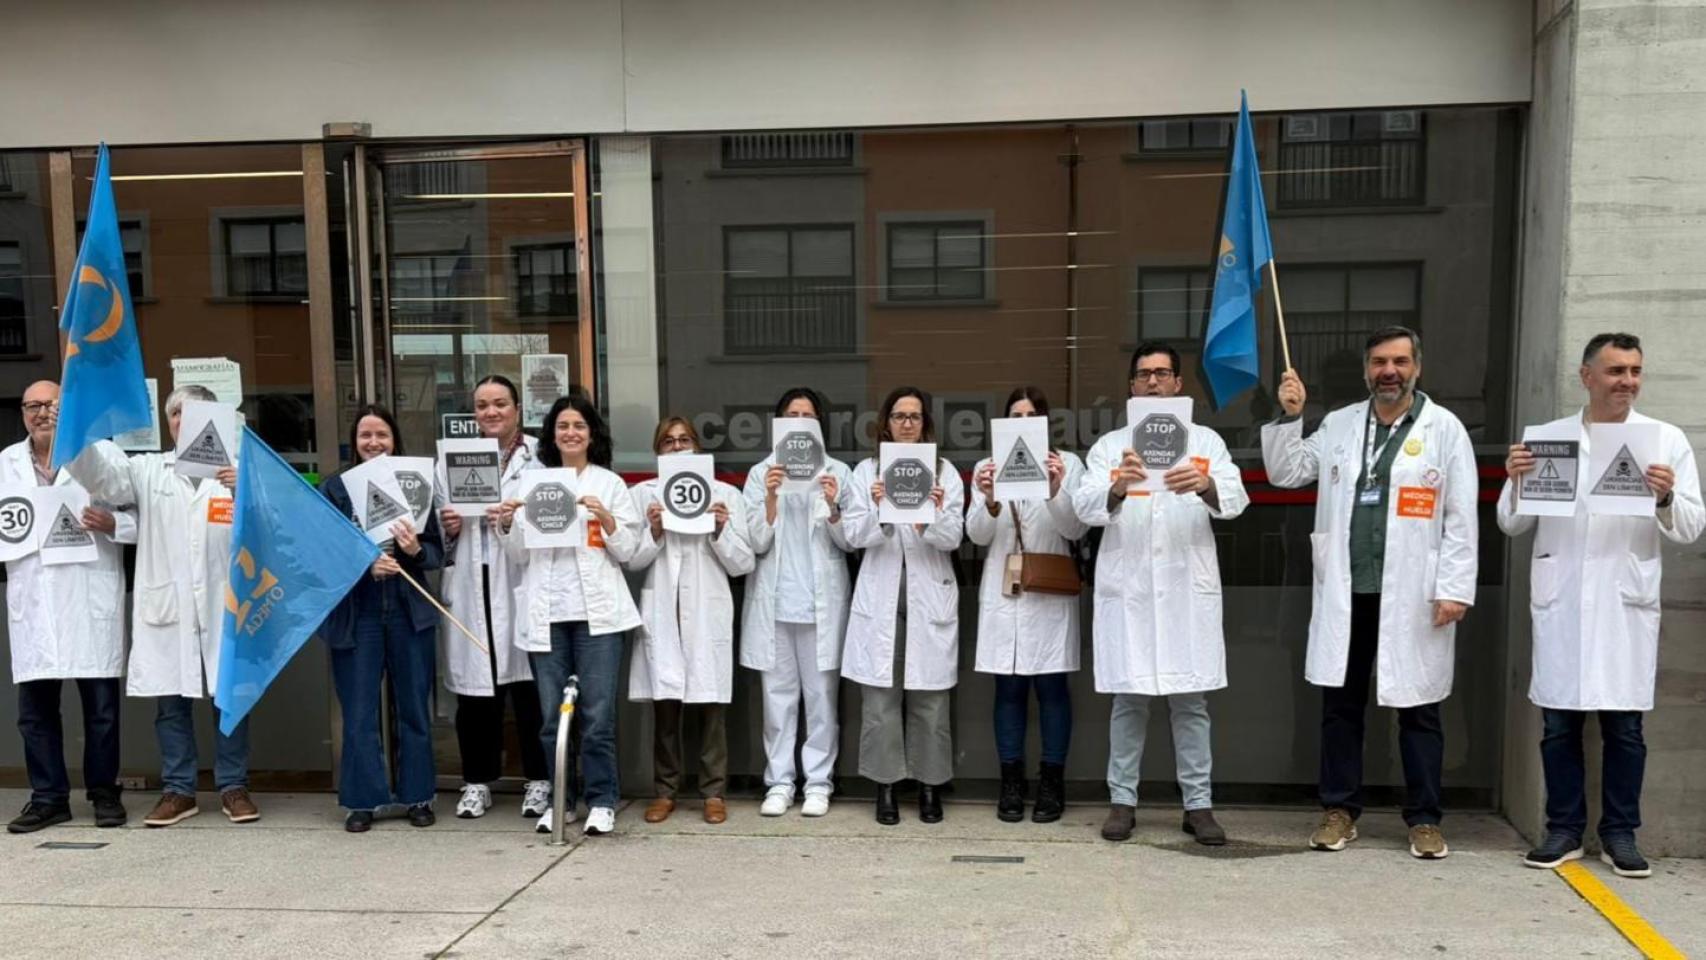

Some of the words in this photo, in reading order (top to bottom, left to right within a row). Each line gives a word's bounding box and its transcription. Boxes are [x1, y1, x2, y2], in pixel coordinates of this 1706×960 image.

[1145, 423, 1176, 433] STOP
[786, 440, 813, 449] STOP
[1530, 444, 1570, 456] WARNING
[455, 455, 491, 465] WARNING
[893, 467, 922, 477] STOP
[400, 480, 421, 489] TOP
[535, 490, 565, 501] STOP
[674, 485, 702, 504] 30
[0, 508, 28, 530] 30
